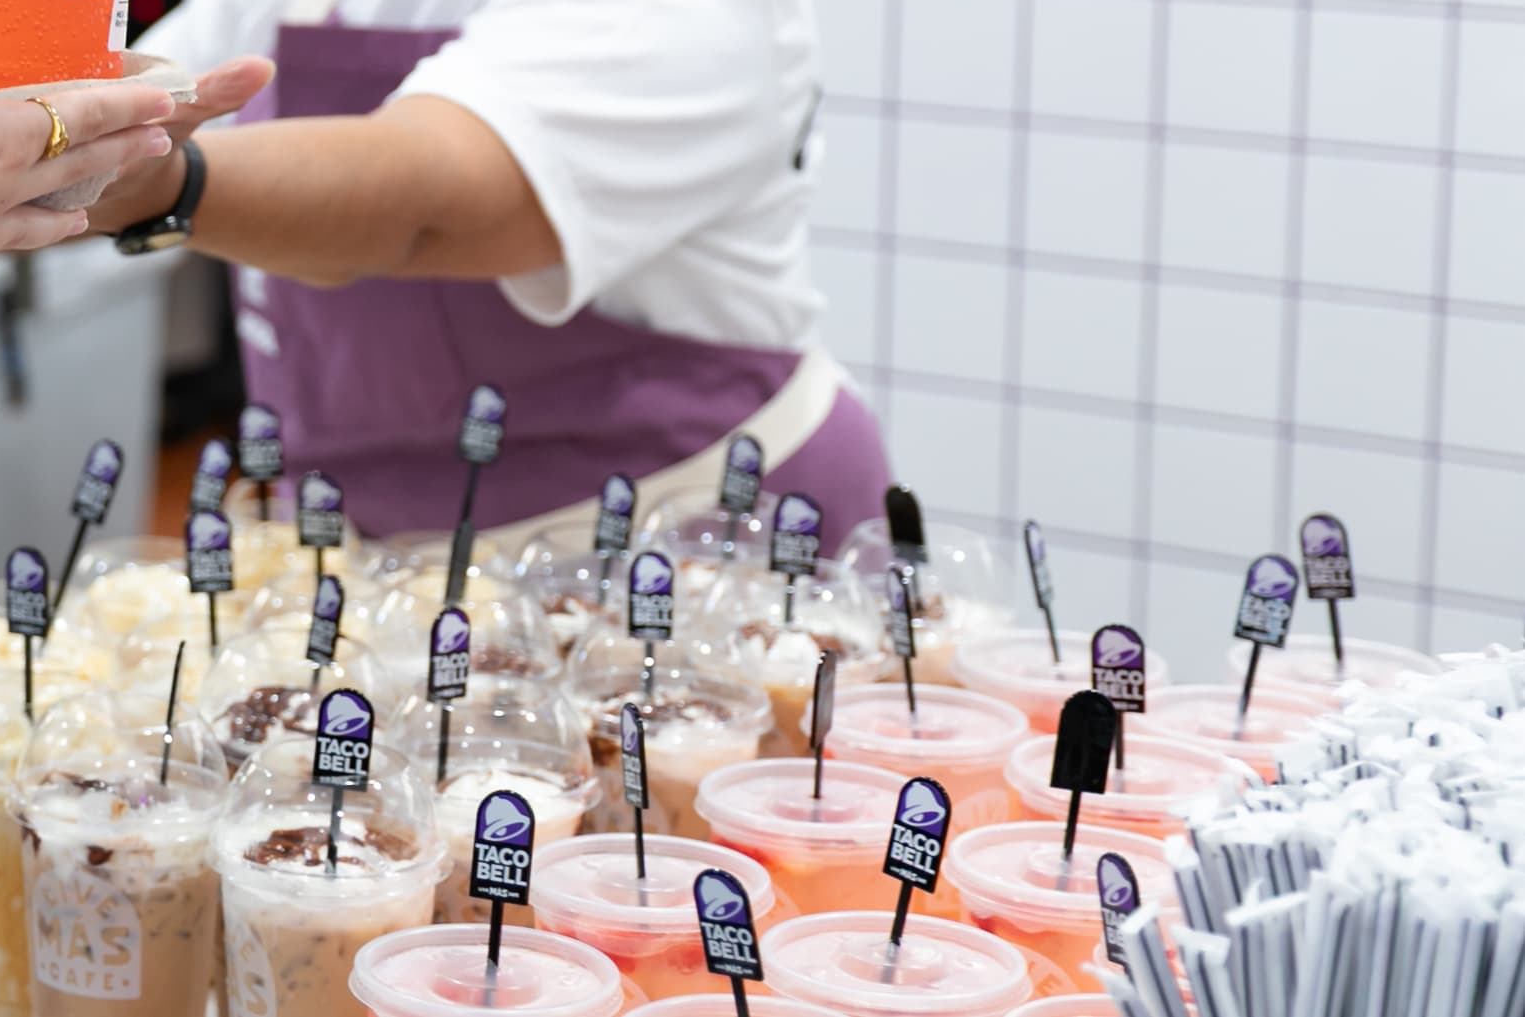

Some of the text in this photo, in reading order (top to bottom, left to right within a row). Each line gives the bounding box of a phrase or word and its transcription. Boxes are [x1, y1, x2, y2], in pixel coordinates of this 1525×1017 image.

[632, 607, 673, 626] BELL
[432, 653, 468, 670] TACO
[433, 667, 468, 687] BELL
[1093, 667, 1144, 684] TACO
[317, 737, 369, 757] TACO
[318, 754, 367, 775] BELL
[893, 824, 940, 856] TACO
[475, 843, 529, 868] TACO
[890, 844, 935, 875] BELL
[477, 862, 527, 886] BELL
[701, 922, 753, 945] TACO
[707, 940, 757, 964] BELL
